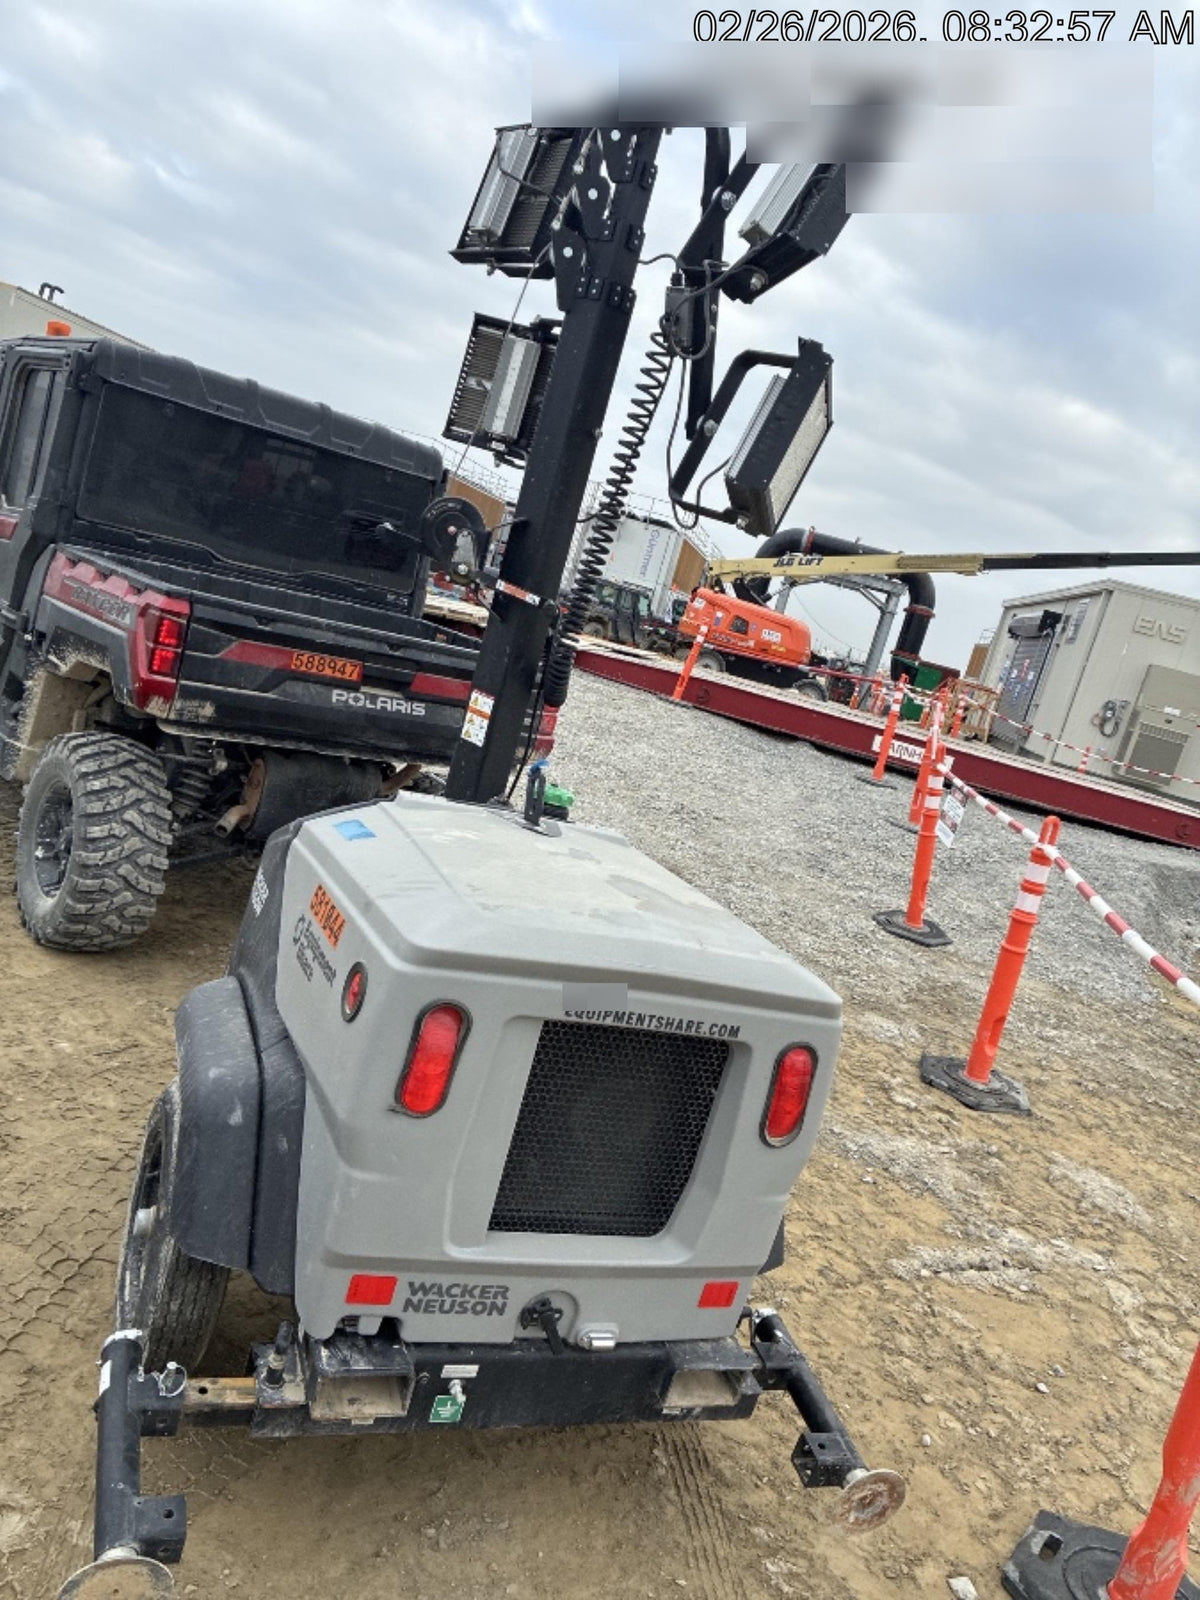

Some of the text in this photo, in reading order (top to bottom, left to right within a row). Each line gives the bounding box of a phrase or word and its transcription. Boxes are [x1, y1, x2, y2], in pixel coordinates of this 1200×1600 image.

[798, 556, 824, 566] LIFT
[293, 654, 358, 678] 588947
[332, 689, 426, 716] POLARIS
[408, 1281, 510, 1300] WACKER
[402, 1297, 507, 1317] NEUSON
